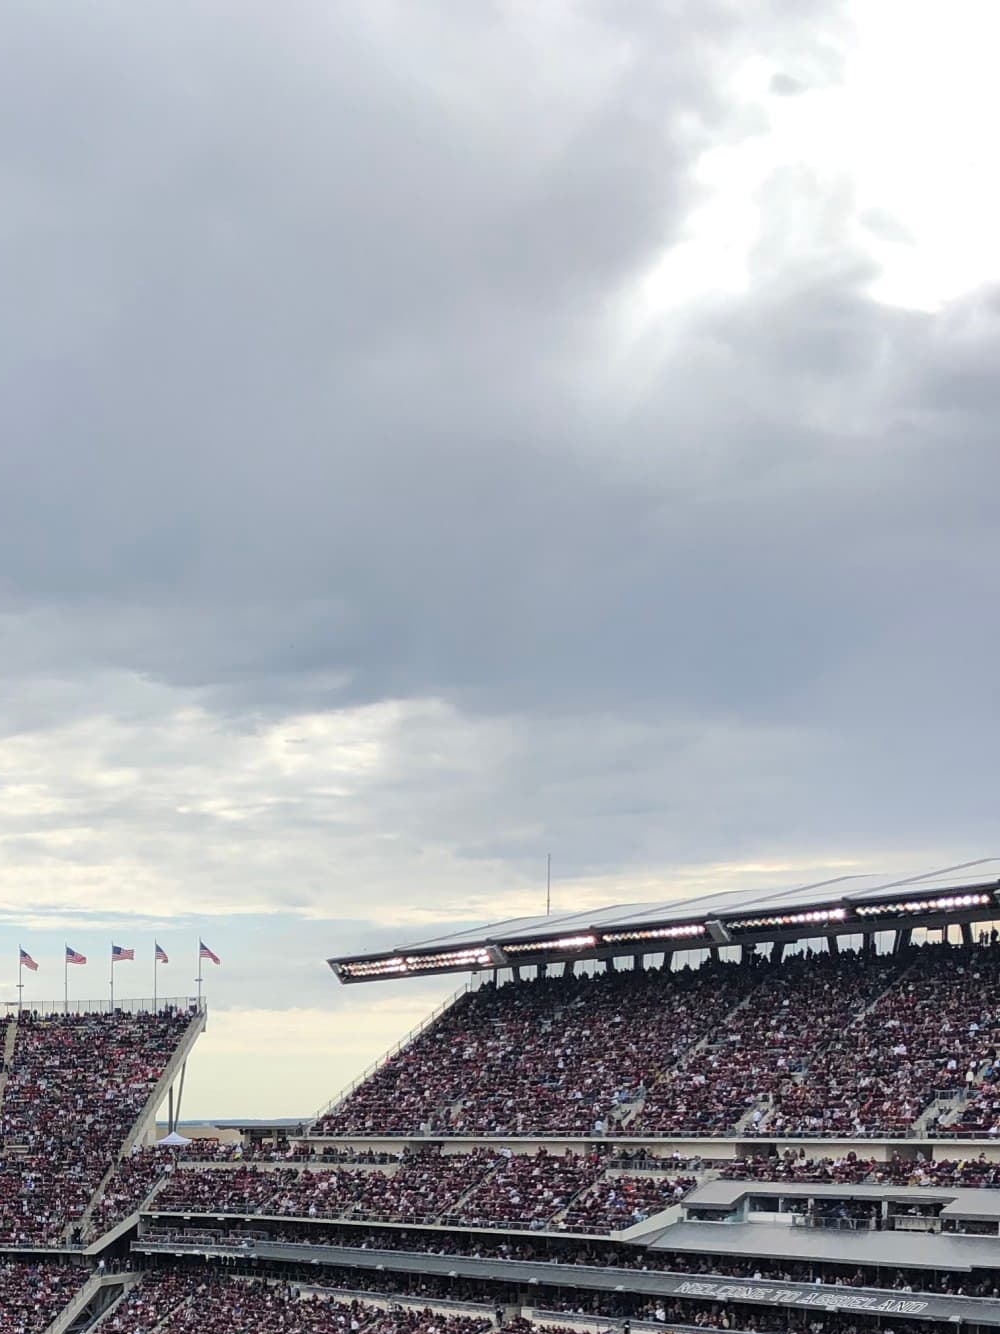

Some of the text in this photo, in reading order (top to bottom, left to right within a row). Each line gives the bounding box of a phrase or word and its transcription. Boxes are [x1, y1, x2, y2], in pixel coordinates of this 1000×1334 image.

[675, 1281, 929, 1314] WELCOME TO AGGIELAND
